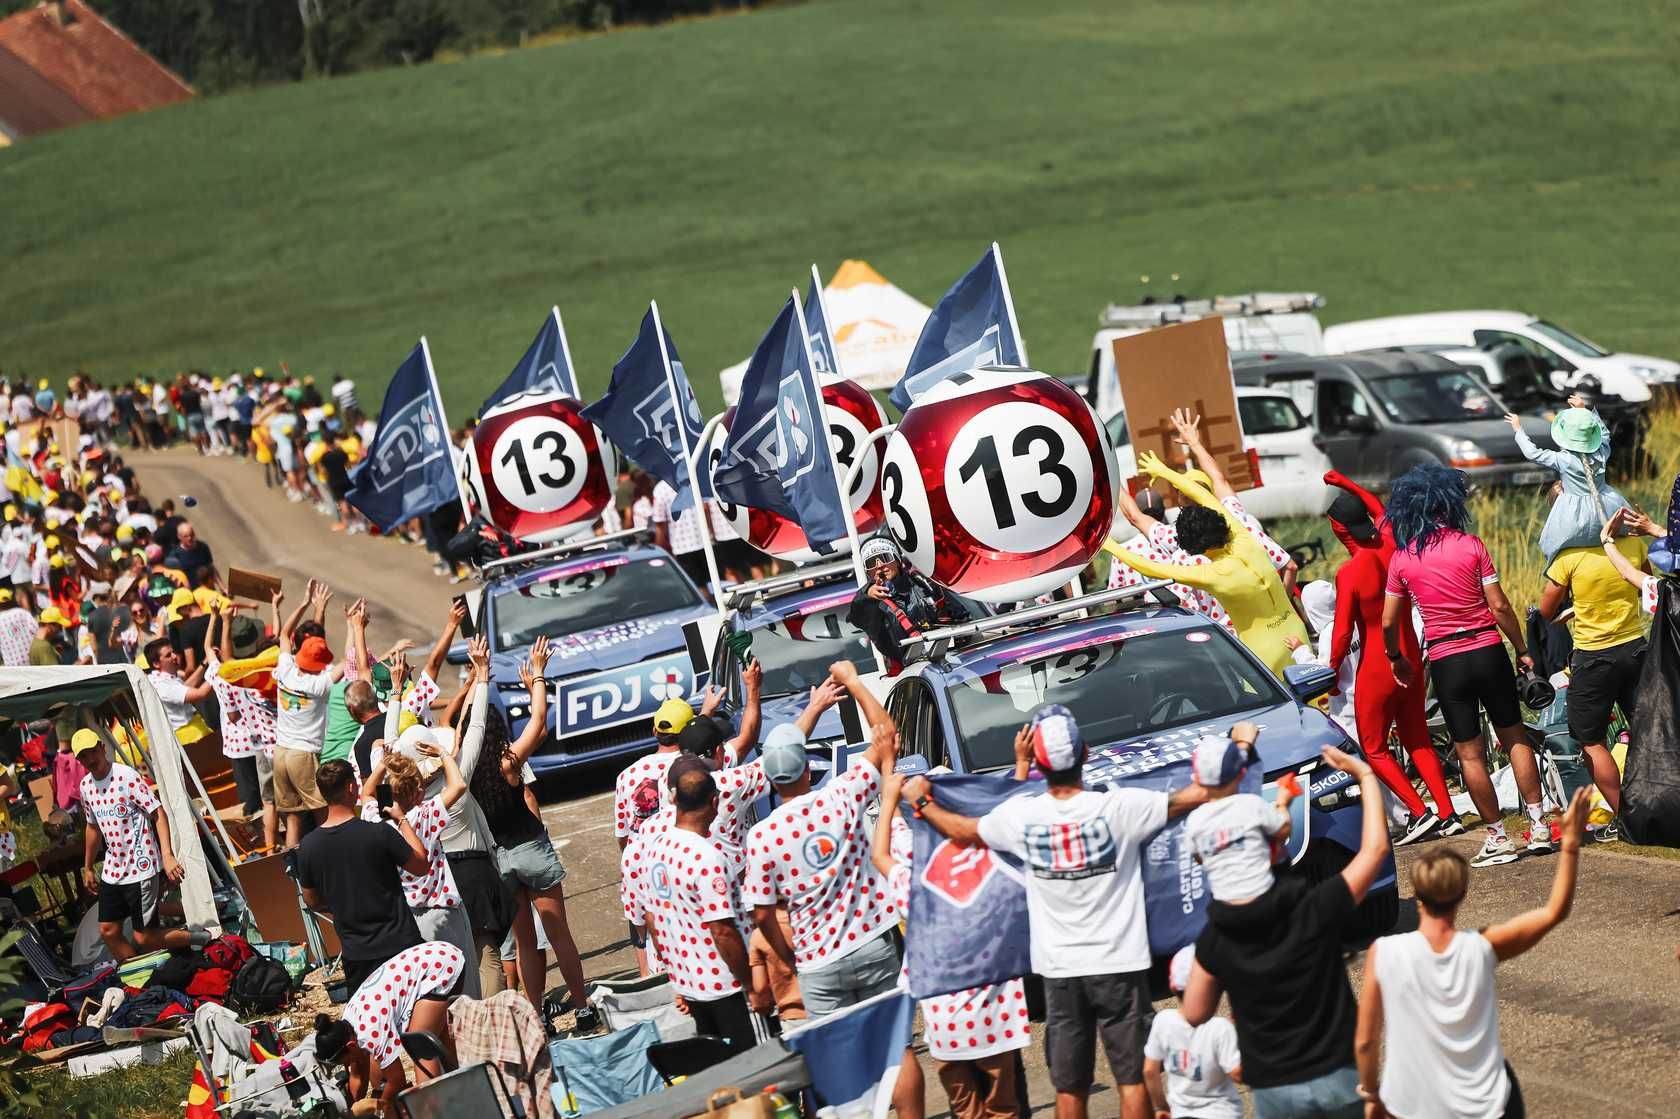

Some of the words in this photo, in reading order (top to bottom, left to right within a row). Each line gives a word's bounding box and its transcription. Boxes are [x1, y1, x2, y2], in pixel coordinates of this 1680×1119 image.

[500, 430, 577, 497] 13
[829, 423, 864, 498] 3
[958, 424, 1078, 531] 13
[567, 674, 641, 727] FDJ
